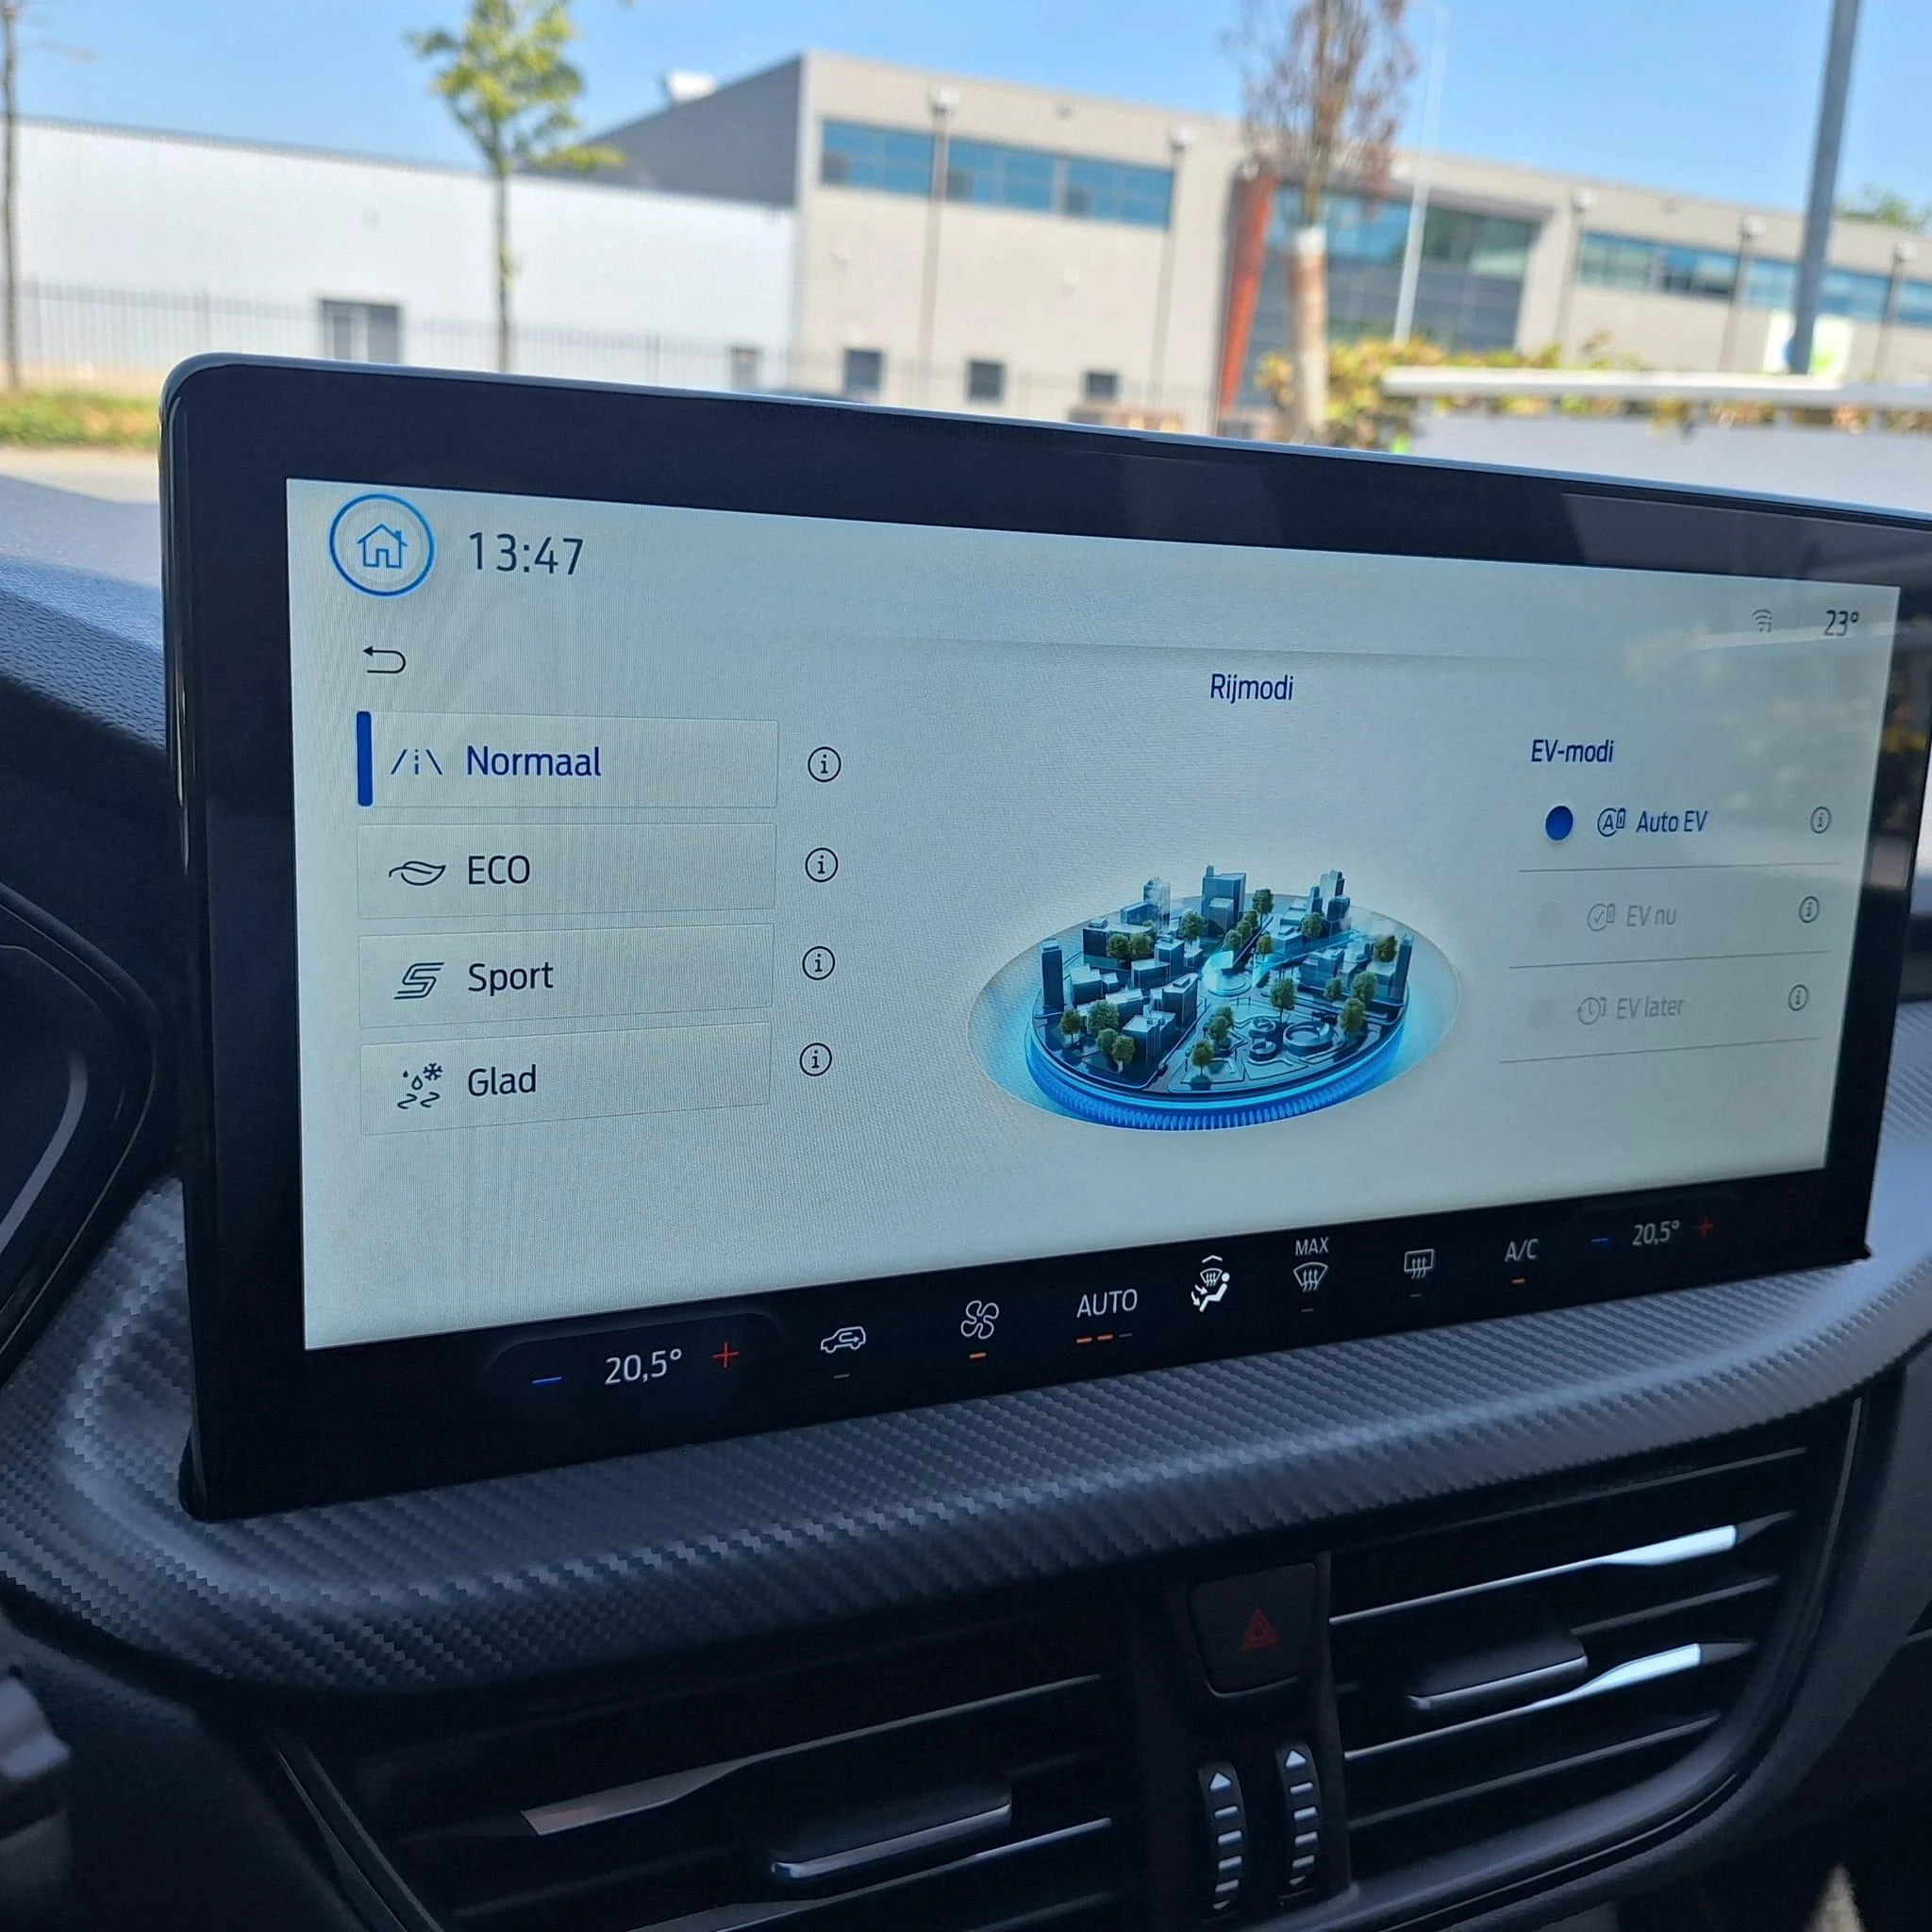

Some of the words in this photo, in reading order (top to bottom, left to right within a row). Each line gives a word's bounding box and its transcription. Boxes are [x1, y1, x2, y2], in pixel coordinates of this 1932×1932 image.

[470, 531, 584, 575] 13:47
[1823, 609, 1859, 636] 23°
[1209, 673, 1295, 704] Rijmodi
[466, 745, 602, 777] Normaal
[1530, 739, 1614, 763] EV-modi
[1636, 809, 1679, 834] Auto
[1683, 809, 1709, 832] EV
[467, 854, 532, 886] ECO
[1625, 906, 1653, 927] EV
[1654, 908, 1676, 926] nu
[467, 960, 555, 996] Sport
[1615, 997, 1643, 1020] EV
[1644, 994, 1685, 1018] later
[467, 1063, 538, 1098] Glad
[1295, 1236, 1330, 1257] MAX
[1504, 1238, 1541, 1262] A/C
[1075, 1287, 1139, 1318] AUTO
[604, 1347, 683, 1386] 20,5°
